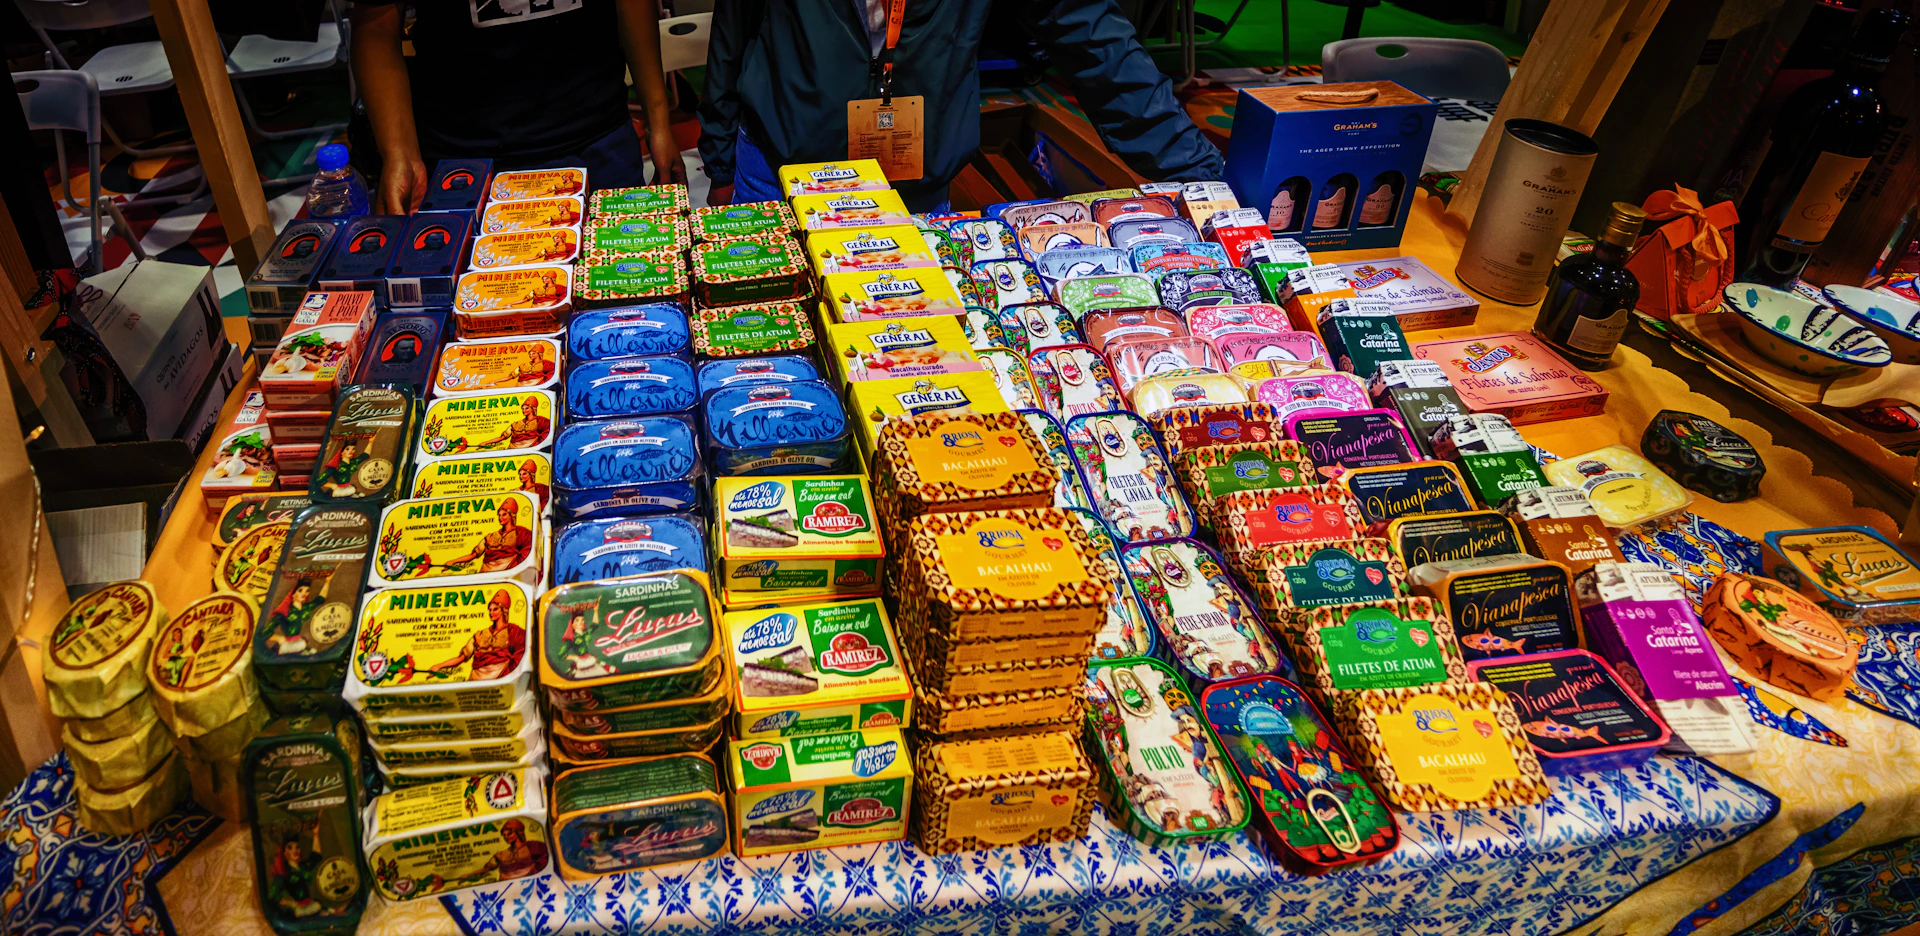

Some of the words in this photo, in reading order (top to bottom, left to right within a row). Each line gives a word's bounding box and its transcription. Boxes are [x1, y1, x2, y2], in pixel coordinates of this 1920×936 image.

[1333, 121, 1378, 131] GRAHAM'S
[507, 172, 561, 181] MINERVA
[812, 169, 854, 178] GENERAL
[1522, 179, 1578, 195] GRAHAM'S
[500, 200, 557, 211] MINERVA
[829, 198, 873, 208] GENERAL
[1535, 206, 1555, 216] 20
[710, 222, 740, 230] FILETES
[491, 231, 552, 243] MINERVA
[601, 238, 632, 246] FILETES
[846, 239, 894, 250] GENERAL
[711, 260, 744, 270] FILETES
[758, 256, 783, 265] ATUM
[476, 270, 542, 282] MINERVA
[1314, 271, 1329, 279] ATUM
[1355, 269, 1396, 289] JANUS
[866, 281, 918, 293] GENERAL
[335, 293, 364, 306] POLVO
[1377, 304, 1391, 312] BON
[715, 332, 750, 341] FILETES
[765, 329, 792, 337] ATUM
[873, 331, 930, 344] GENERAL
[1364, 332, 1384, 341] Santa
[1359, 337, 1400, 349] Catarina
[459, 344, 528, 357] MINERVA
[1467, 347, 1512, 373] JANUS
[890, 365, 921, 373] Bacalhau
[922, 363, 944, 371] curado
[1460, 374, 1506, 390] Filetes
[1503, 371, 1522, 385] de
[1520, 367, 1569, 383] Salmão
[446, 396, 520, 412] MINERVA
[902, 390, 963, 405] GENERAL
[1423, 405, 1442, 413] Santa
[940, 430, 984, 448] BRIOSA
[948, 446, 987, 457] GOURMET
[437, 459, 517, 476] MINERVA
[941, 456, 1008, 472] BACALHAU
[1108, 475, 1136, 490] FILETES
[1136, 473, 1147, 487] DE
[1500, 472, 1521, 481] Santa
[805, 480, 845, 488] Sardinhas
[1497, 480, 1542, 492] Catarina
[729, 499, 757, 510] menos
[756, 487, 784, 509] sal
[746, 483, 772, 501] 78%
[798, 489, 824, 502] Baixo
[823, 493, 837, 501] em
[1123, 487, 1155, 502] CAVALA
[279, 498, 313, 506] PETINGA
[406, 497, 496, 520] MINERVA
[592, 498, 623, 509] SARDINES
[631, 497, 649, 505] OLIVE
[650, 497, 661, 505] OIL
[306, 511, 368, 528] SARDINHAS
[404, 522, 439, 531] SARDINHAS
[439, 521, 449, 529] EM
[449, 519, 470, 528] AZEITE
[471, 517, 496, 526] PICANTE
[806, 515, 861, 530] RAMIREZ
[444, 526, 470, 535] PICKLES
[802, 539, 844, 547] Alimentação
[976, 528, 1026, 549] BRIOSA
[984, 548, 1028, 560] GOURMET
[1564, 547, 1613, 562] Catarina
[977, 561, 1054, 577] BACALHAU
[615, 580, 680, 598] SARDINHAS
[389, 589, 487, 611] MINERVA
[817, 606, 861, 617] Sardinhas
[1461, 584, 1562, 631] Vianapesca
[386, 616, 423, 626] SARDINHAS
[423, 615, 436, 623] EM
[436, 614, 458, 622] AZEITE
[458, 611, 486, 621] PICANTE
[812, 618, 841, 636] Baixo
[839, 622, 854, 632] em
[853, 613, 872, 631] sal
[1174, 610, 1231, 634] PEIXE-ESPADA
[739, 636, 768, 652] menos
[766, 618, 796, 647] sal
[743, 629, 756, 640] até
[755, 616, 784, 638] 78%
[1646, 634, 1699, 648] Catarina
[824, 647, 882, 667] RAMIREZ
[1337, 661, 1382, 676] FILETES
[1383, 660, 1401, 673] DE
[1402, 657, 1436, 671] ATUM
[822, 679, 868, 690] Alimentação
[867, 676, 901, 686] Saudável
[1695, 680, 1726, 691] Alecrim
[1139, 744, 1186, 773] POLVO
[1417, 751, 1488, 769] BACALHAU
[832, 807, 891, 822] RAMIREZ
[392, 821, 500, 852] MINERVA
